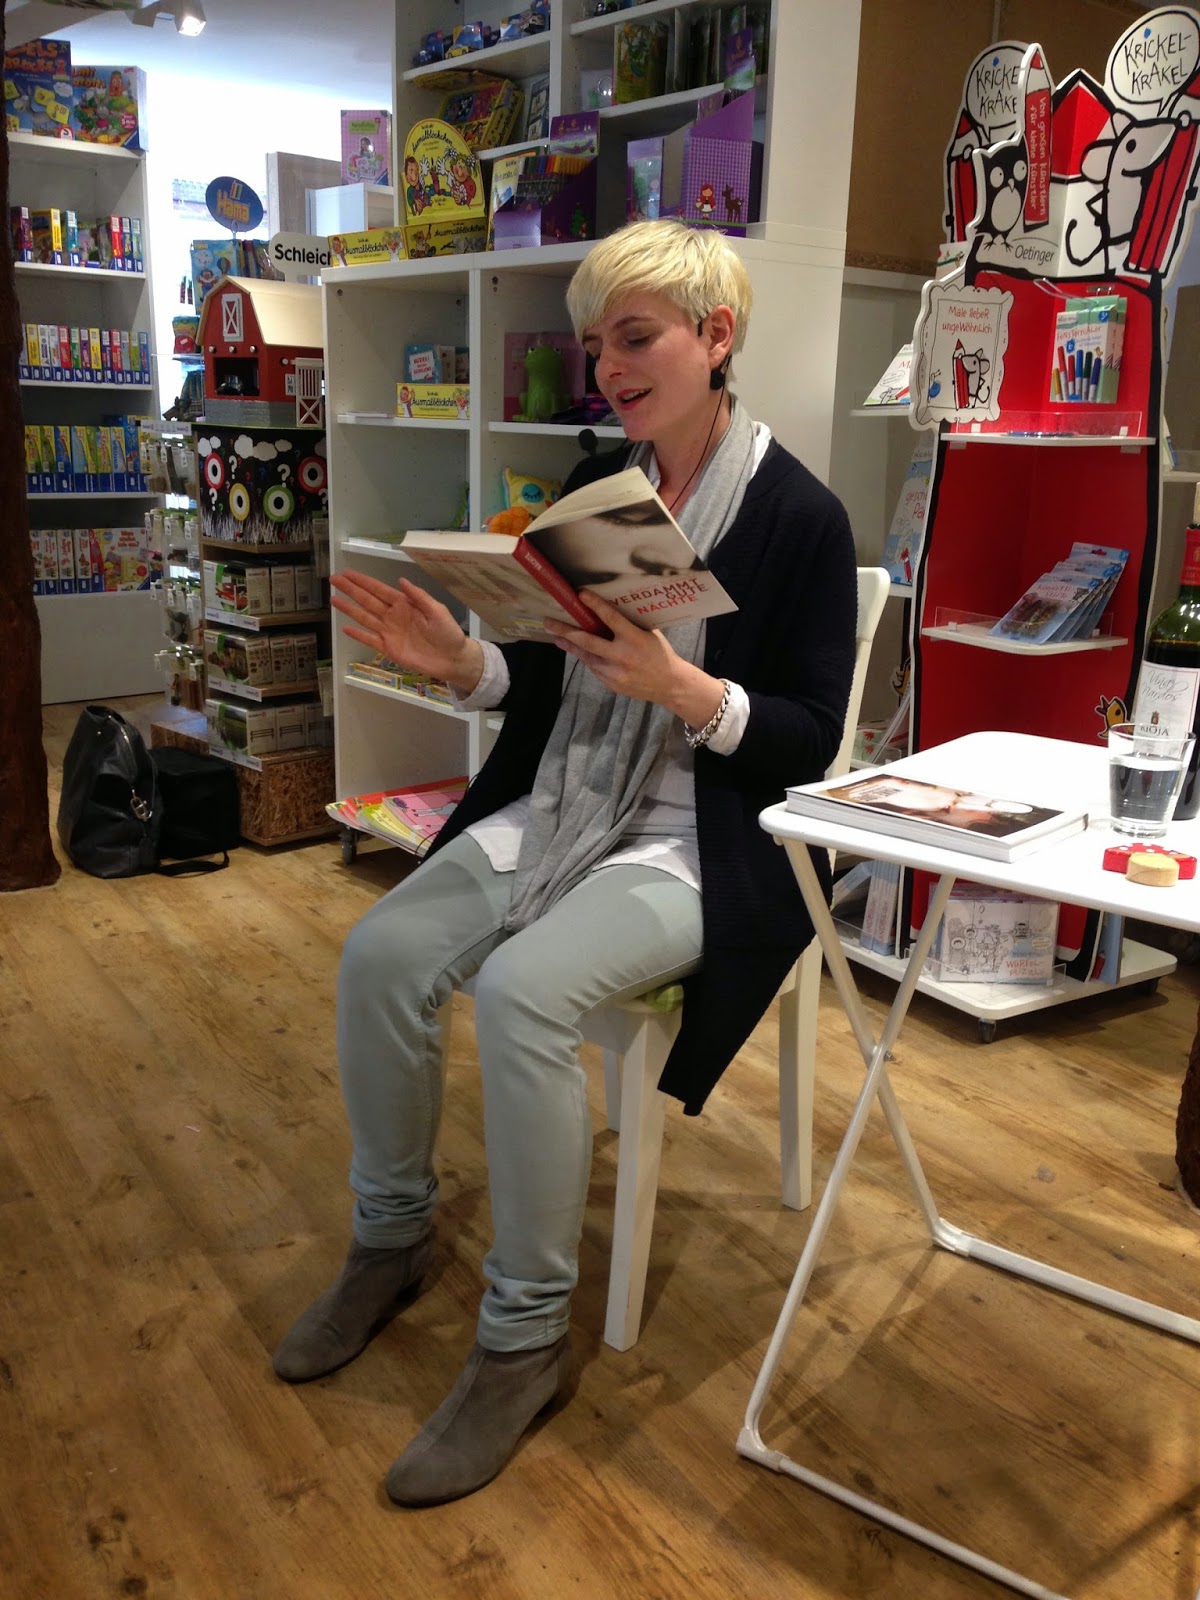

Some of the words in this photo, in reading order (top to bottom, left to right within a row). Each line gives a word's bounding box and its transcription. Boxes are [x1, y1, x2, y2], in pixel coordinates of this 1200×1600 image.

[1125, 32, 1192, 75] KRICKEL-
[976, 64, 1020, 98] KRICKE
[1132, 57, 1187, 95] KRAKEL
[980, 90, 1018, 119] KRAKE
[1029, 105, 1037, 126] für
[1039, 97, 1047, 118] Von
[217, 189, 250, 224] Hama
[1015, 244, 1055, 266] Oetinger
[609, 578, 698, 606] VERDAMMT
[665, 583, 709, 600] GUTE
[1140, 725, 1169, 737] RIOJA
